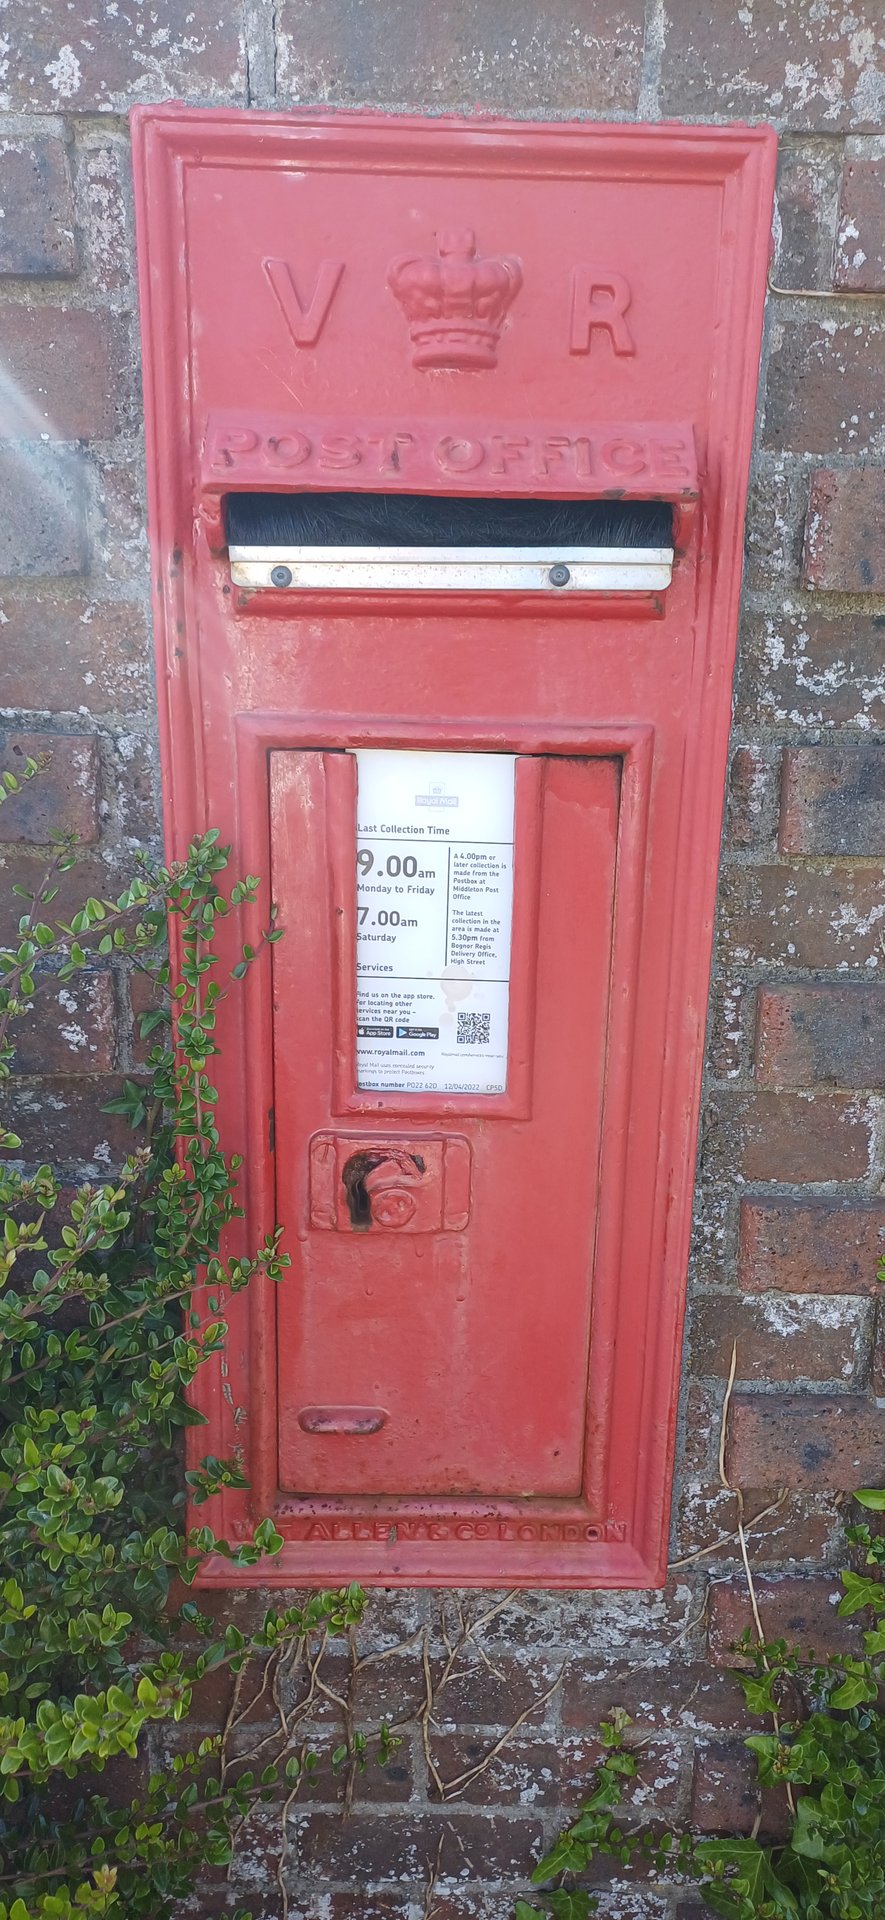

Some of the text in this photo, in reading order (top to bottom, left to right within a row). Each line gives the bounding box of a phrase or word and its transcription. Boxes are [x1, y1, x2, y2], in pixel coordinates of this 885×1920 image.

[261, 257, 636, 357] V R
[210, 425, 691, 479] POST OFFICE
[357, 823, 450, 836] Last Collection Time
[460, 853, 487, 861] 4.00pm
[357, 849, 436, 878] 9.00am
[356, 883, 435, 896] Monday to Friday
[453, 885, 484, 893] Middleton
[357, 906, 418, 927] 7.00am
[356, 932, 397, 943] Saturday
[451, 933, 478, 942] 5.30pm
[451, 942, 473, 950] Bognor
[450, 950, 498, 959] Delivery Office,
[356, 962, 394, 972] Services
[450, 958, 465, 966] High
[367, 999, 393, 1007] locating
[444, 1083, 480, 1091] 12/04/2022
[304, 1520, 415, 1541] ALLEN
[498, 1520, 627, 1542] LONDON
